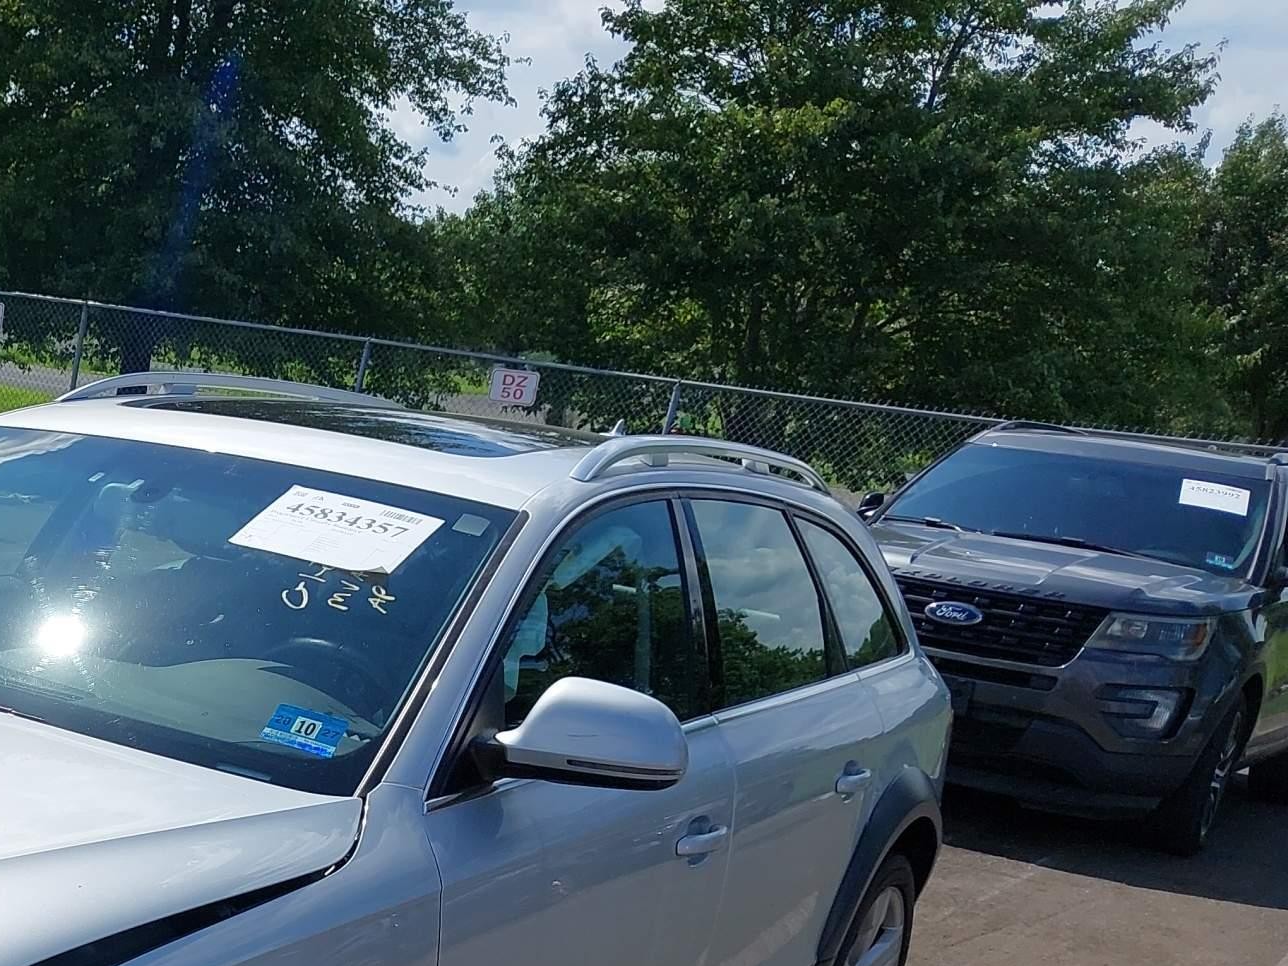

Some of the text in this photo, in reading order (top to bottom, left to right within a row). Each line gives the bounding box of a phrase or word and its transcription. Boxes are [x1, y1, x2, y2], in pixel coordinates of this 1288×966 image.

[502, 374, 529, 388] DZ
[501, 386, 524, 400] 50
[286, 502, 410, 538] 45834357
[367, 585, 396, 614] AP
[935, 604, 969, 621] Ford
[294, 720, 317, 736] 10
